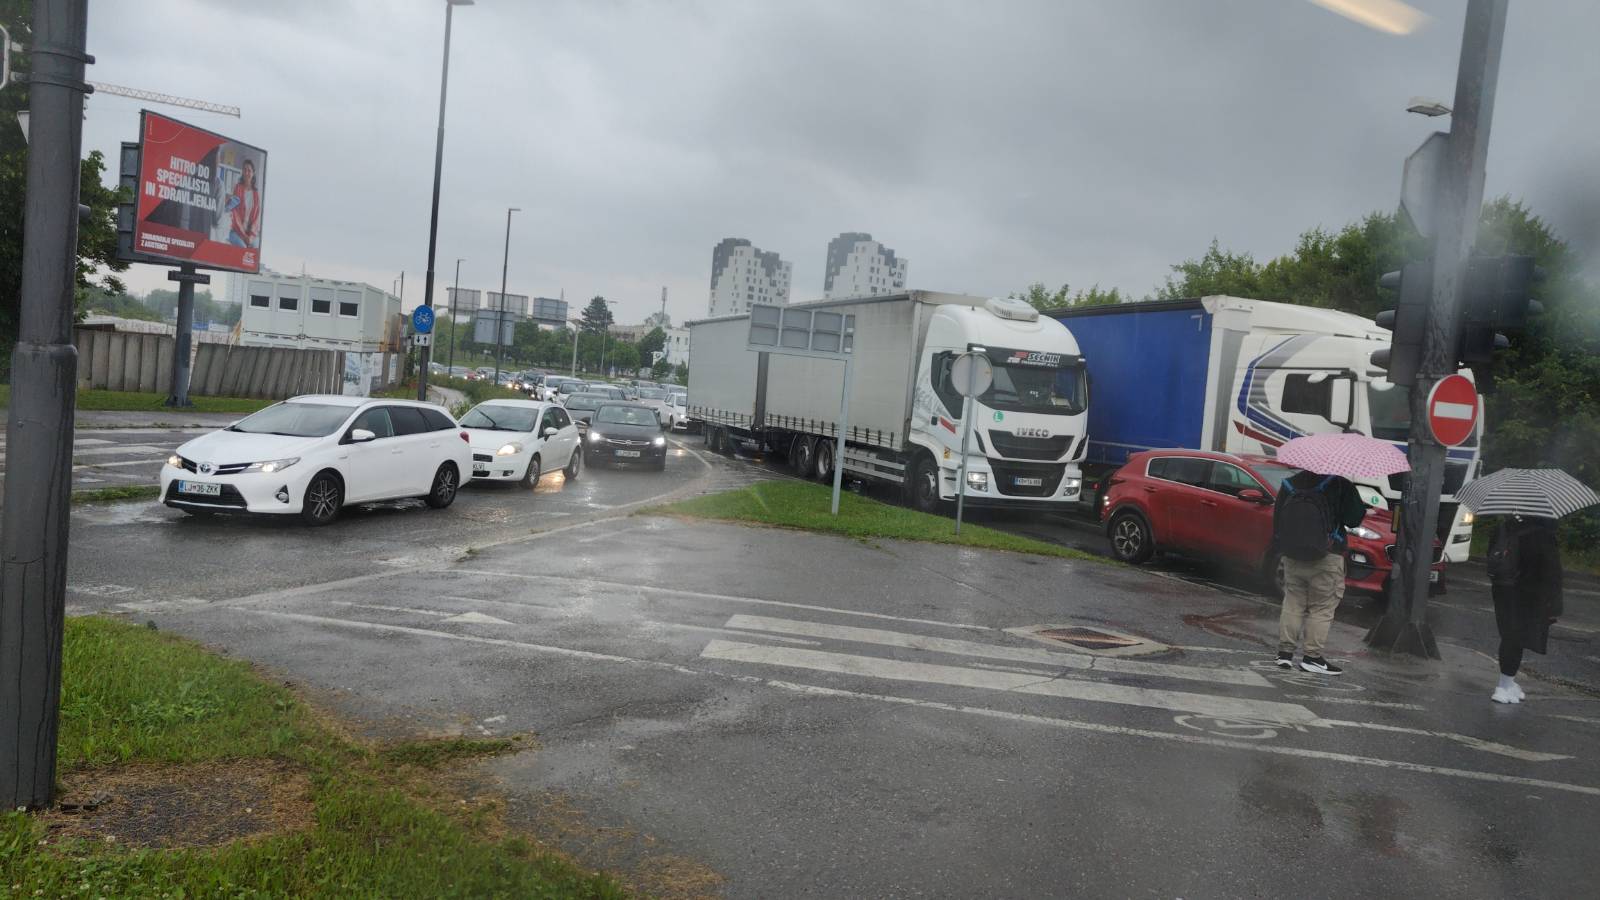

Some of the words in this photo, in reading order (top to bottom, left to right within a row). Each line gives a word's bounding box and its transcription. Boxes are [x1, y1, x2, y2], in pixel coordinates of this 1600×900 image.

[170, 155, 196, 175] HITRO
[197, 163, 210, 179] DO
[156, 168, 210, 195] SPECIALISTA
[145, 181, 156, 197] IN
[158, 184, 217, 211] ZDRAVLJENJA
[1016, 427, 1049, 438] IVECO
